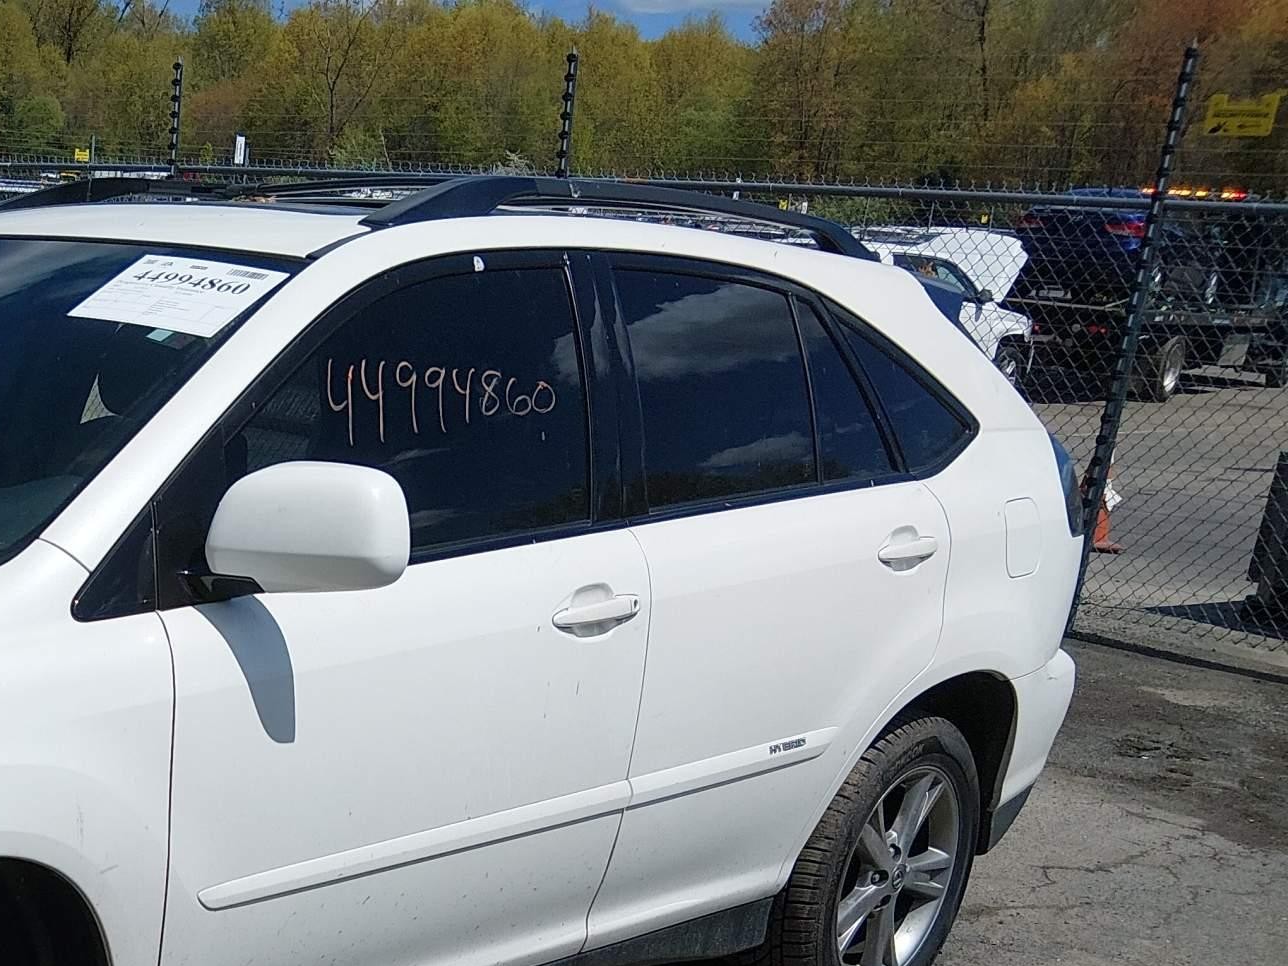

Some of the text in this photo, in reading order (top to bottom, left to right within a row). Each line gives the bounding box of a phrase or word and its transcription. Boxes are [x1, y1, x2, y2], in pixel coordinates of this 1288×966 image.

[133, 269, 251, 295] 44994860
[327, 357, 556, 447] 44994860
[768, 736, 807, 755] HYBRID
